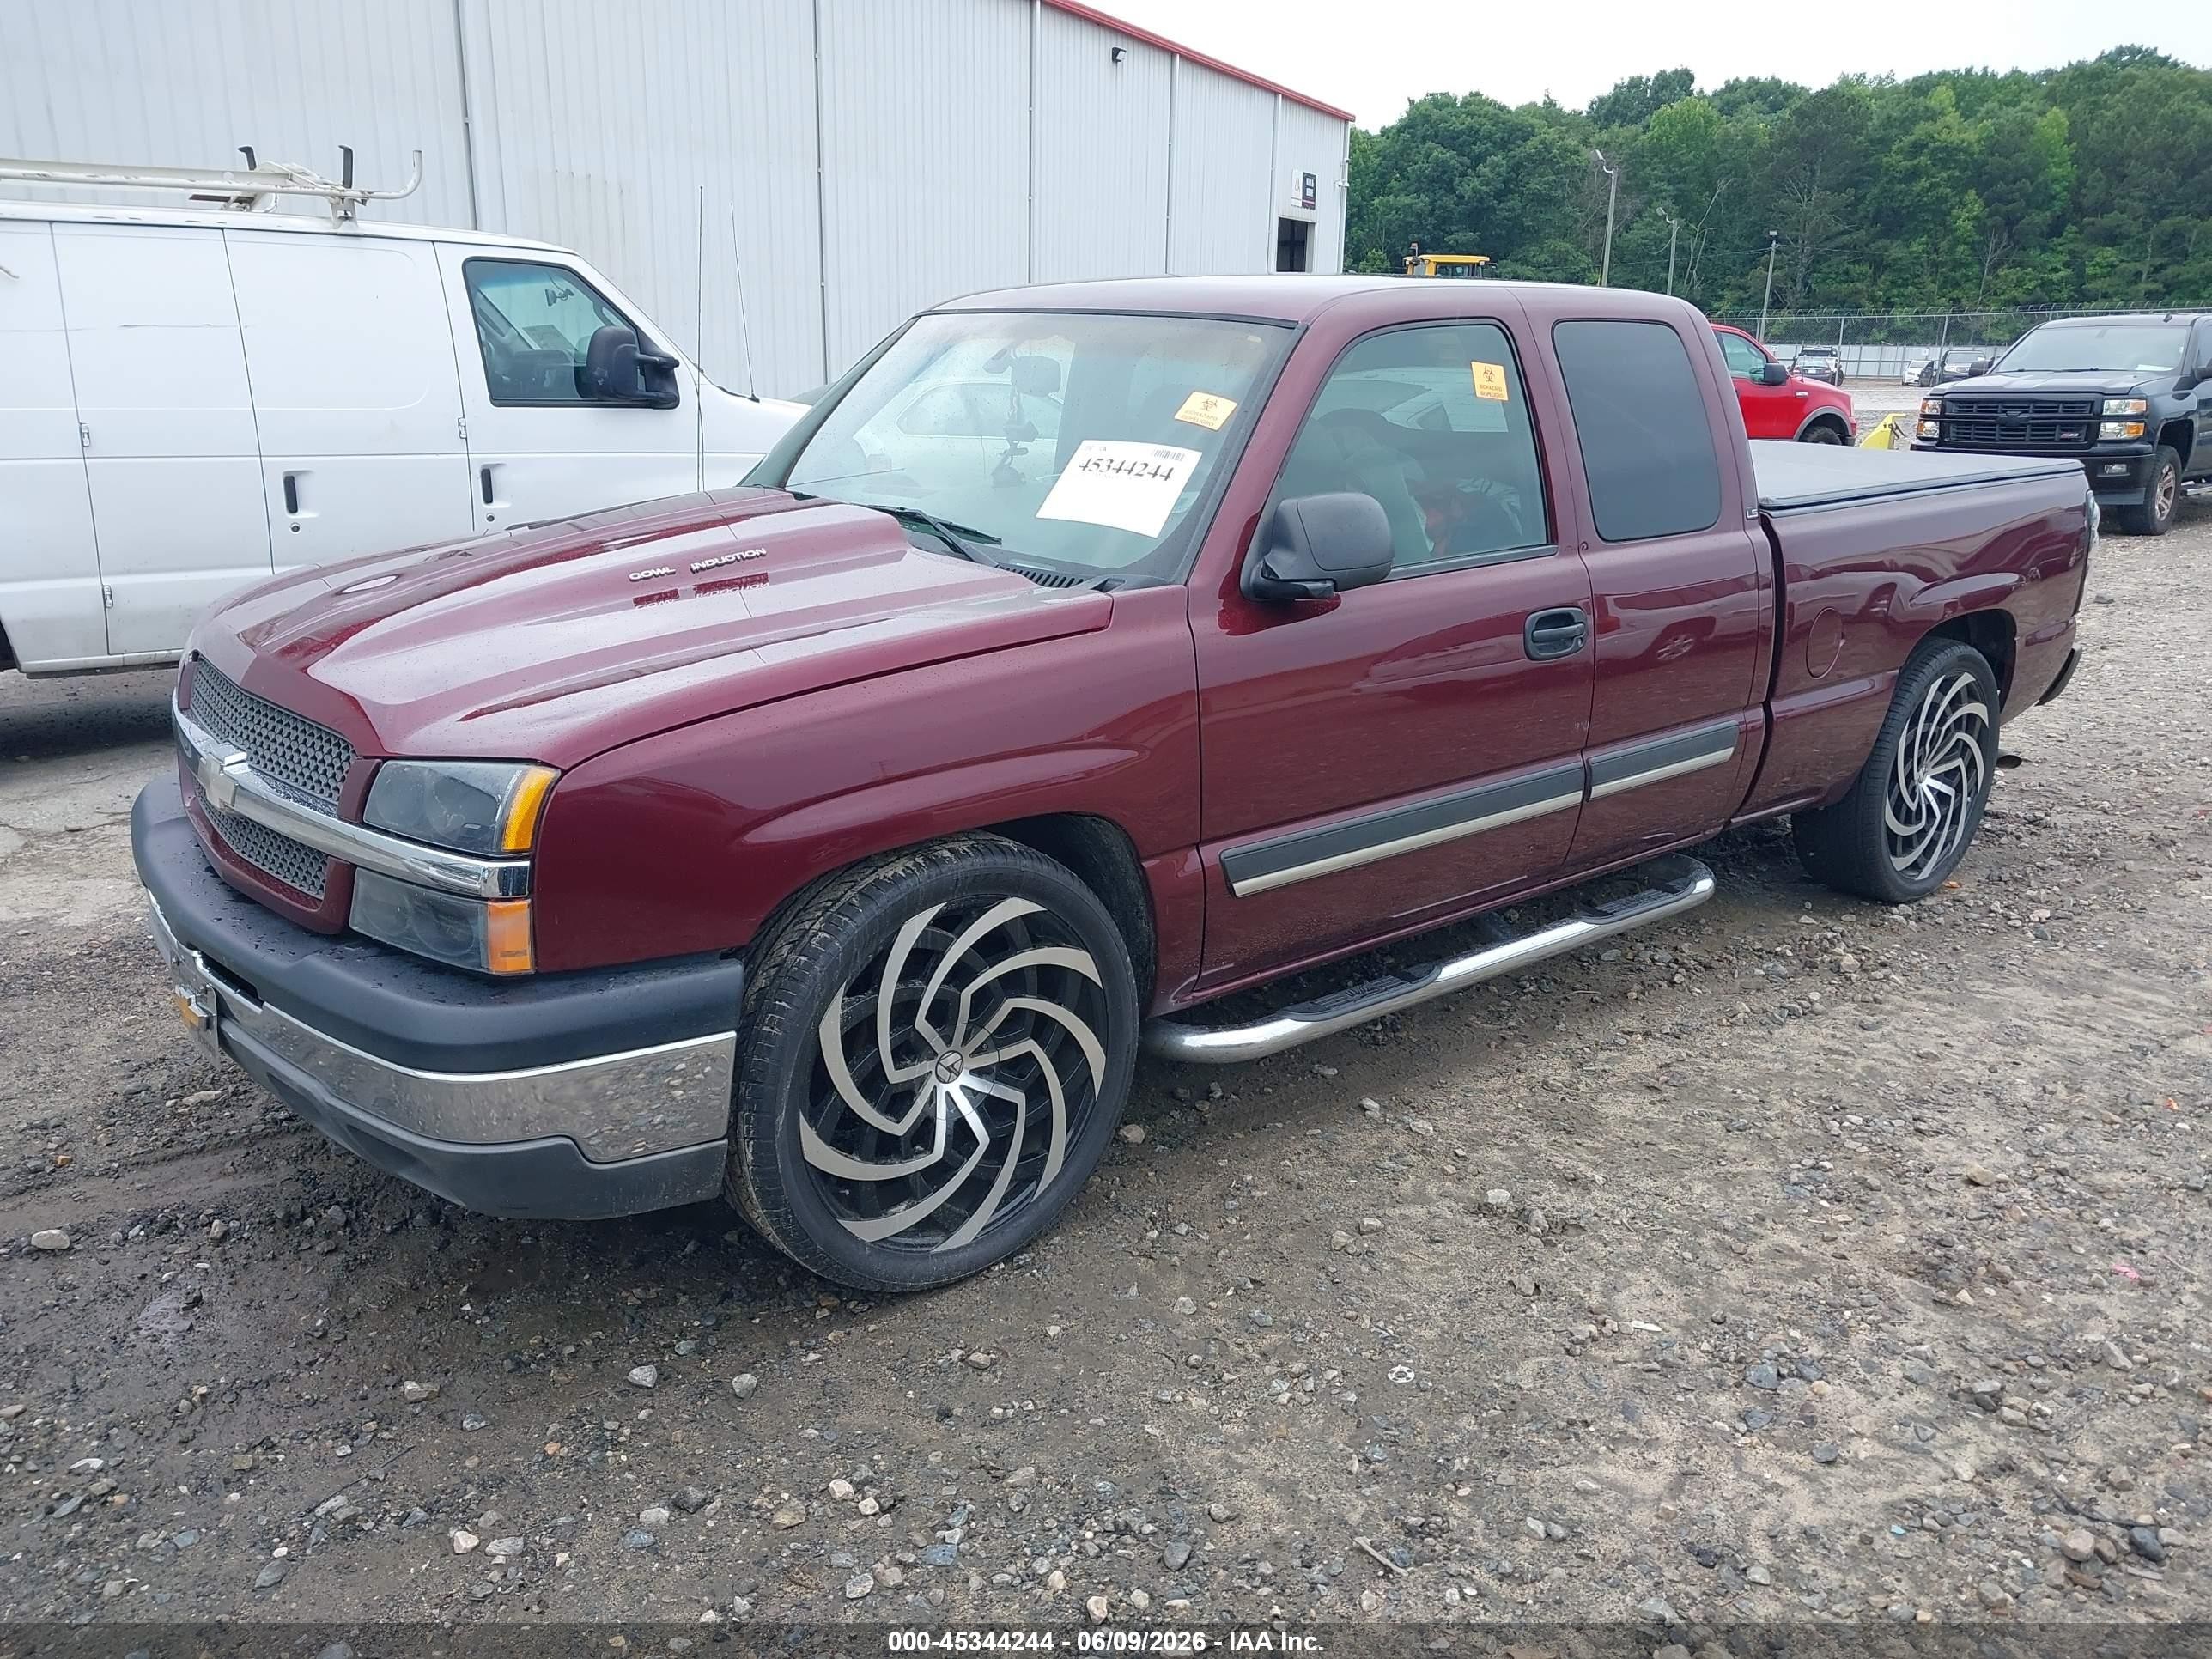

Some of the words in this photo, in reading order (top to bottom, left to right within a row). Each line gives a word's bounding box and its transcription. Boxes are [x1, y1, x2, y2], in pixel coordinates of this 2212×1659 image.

[1079, 457, 1175, 481] 45344244
[1747, 508, 1758, 518] LS
[629, 567, 676, 581] COWL
[690, 547, 768, 574] INDUCTION
